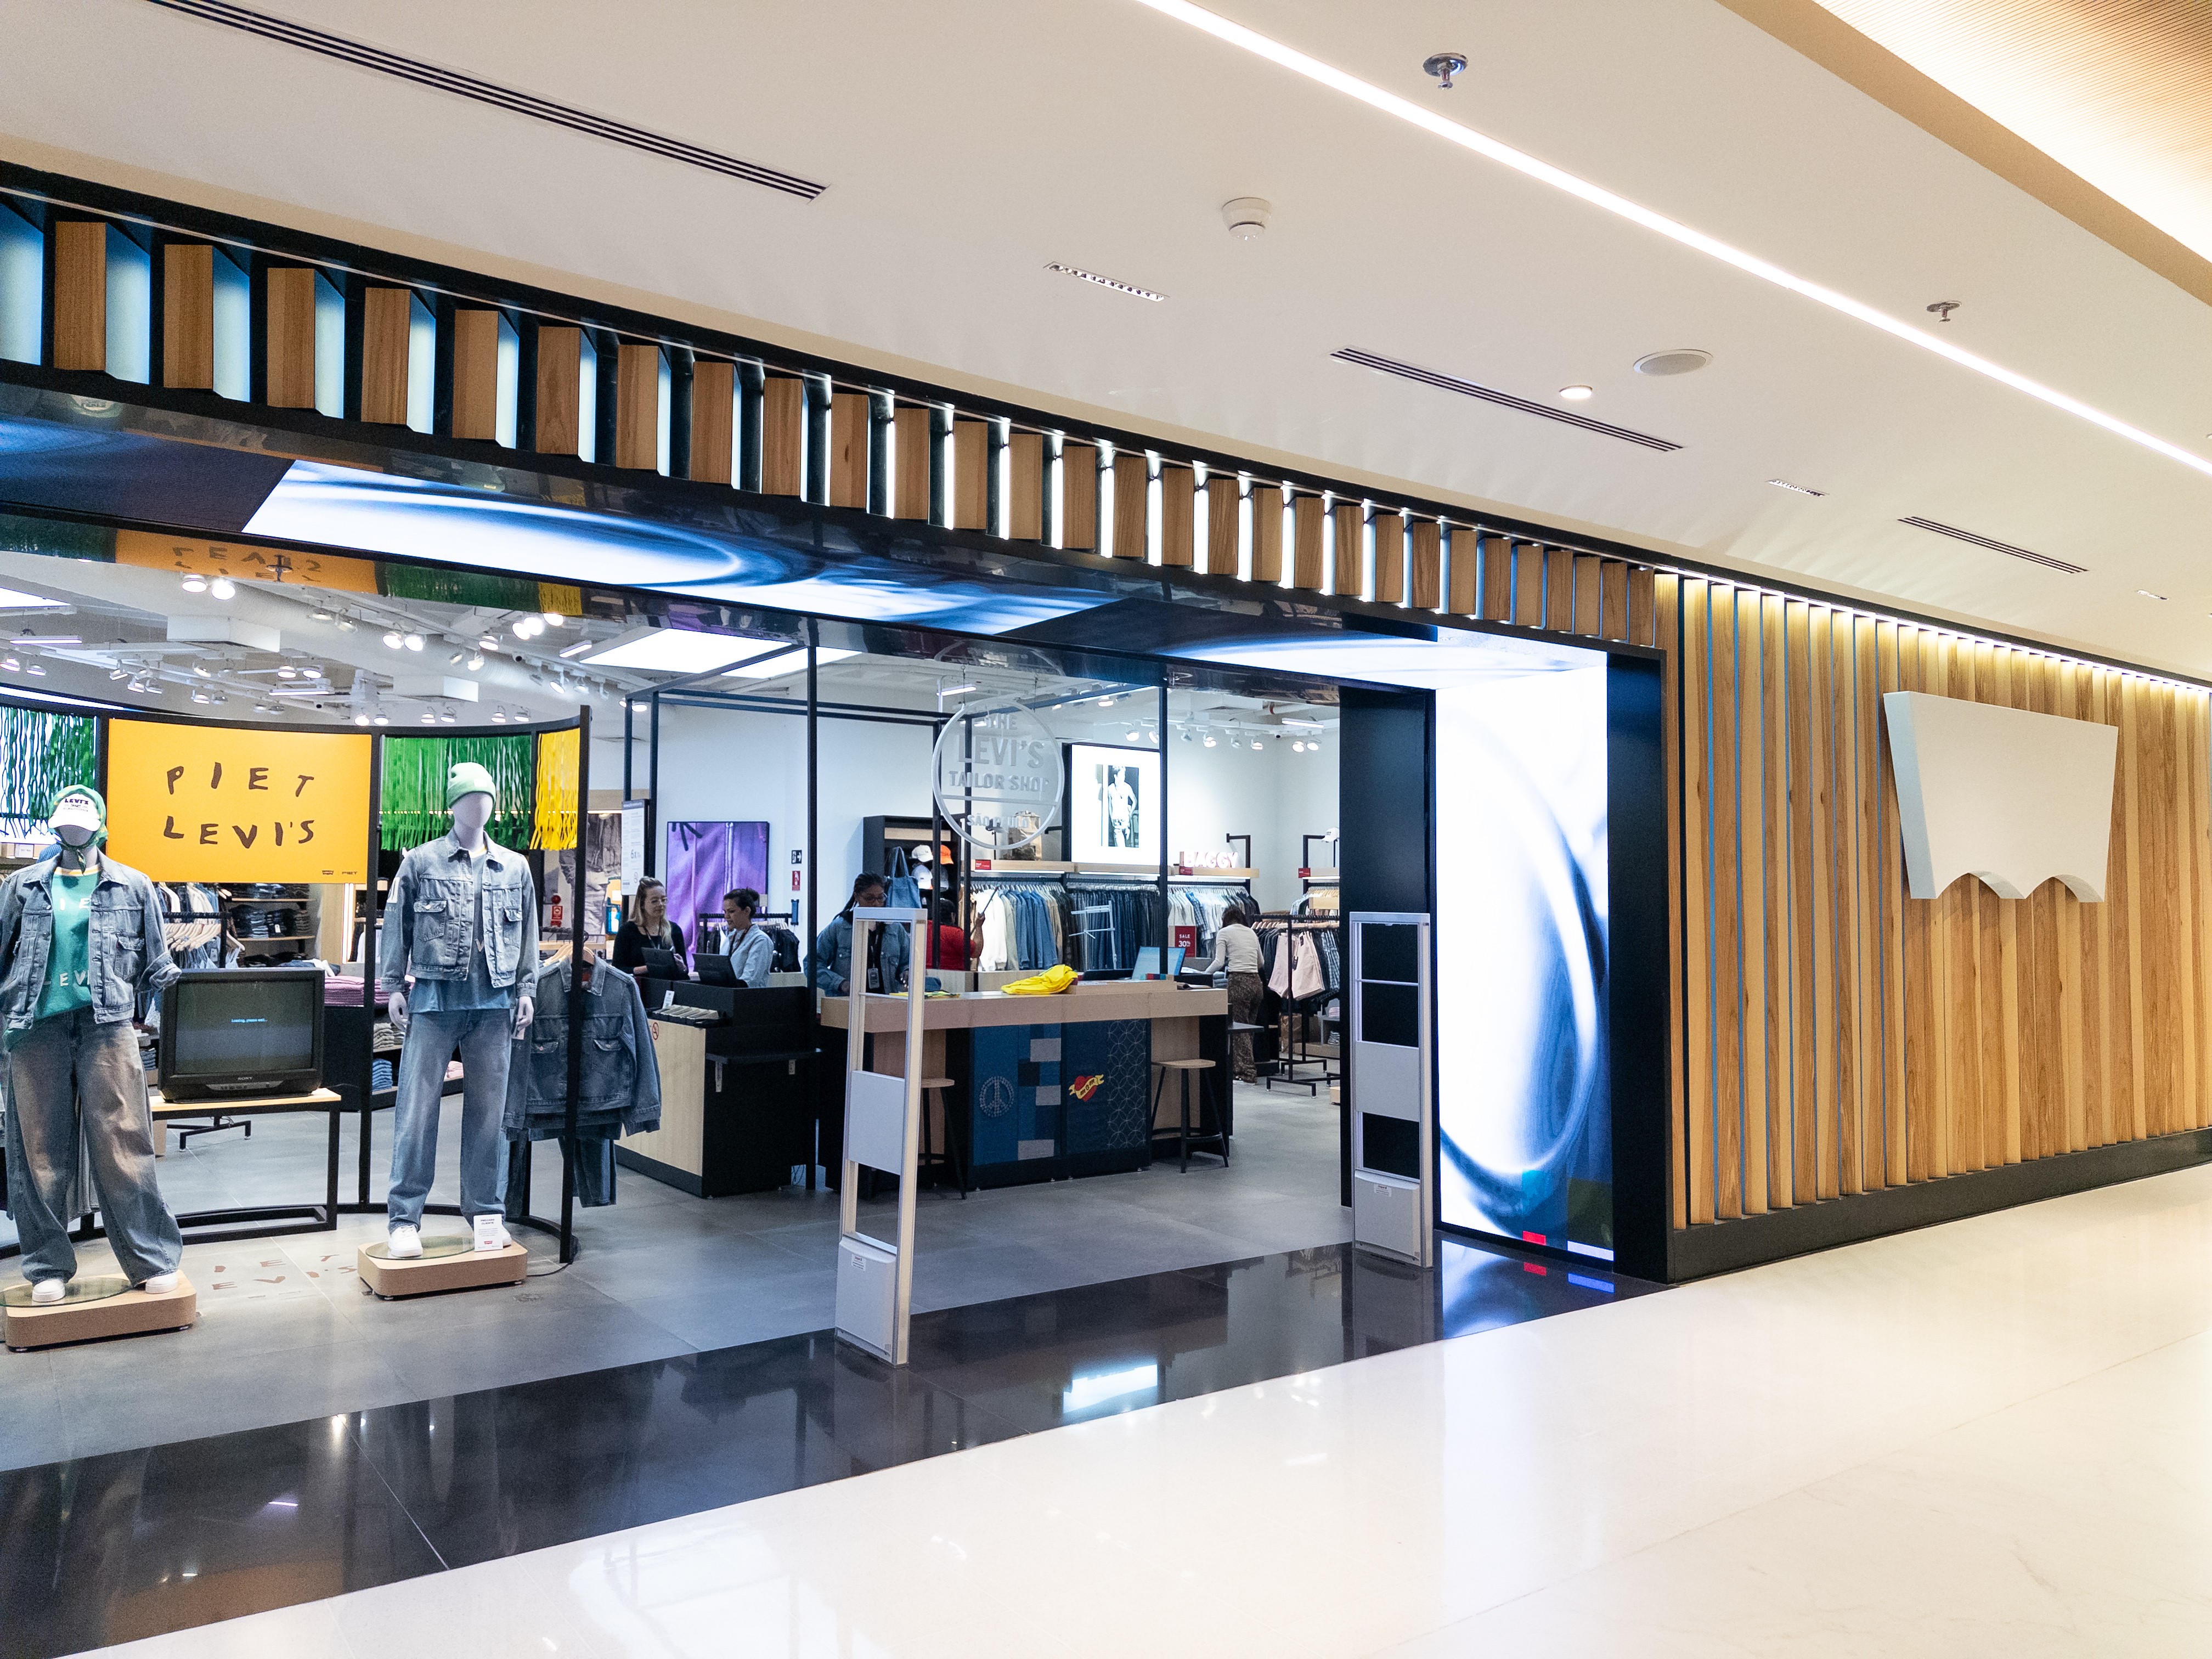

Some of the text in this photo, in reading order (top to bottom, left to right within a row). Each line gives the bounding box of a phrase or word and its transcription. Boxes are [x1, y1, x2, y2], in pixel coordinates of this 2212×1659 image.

[989, 713, 1017, 730] THE
[957, 733, 1045, 769] LEVI'S
[167, 761, 314, 798] PIET
[949, 770, 1050, 793] TAILOR SHOP
[163, 815, 315, 849] LEVI'S
[1180, 851, 1239, 869] BAGGY
